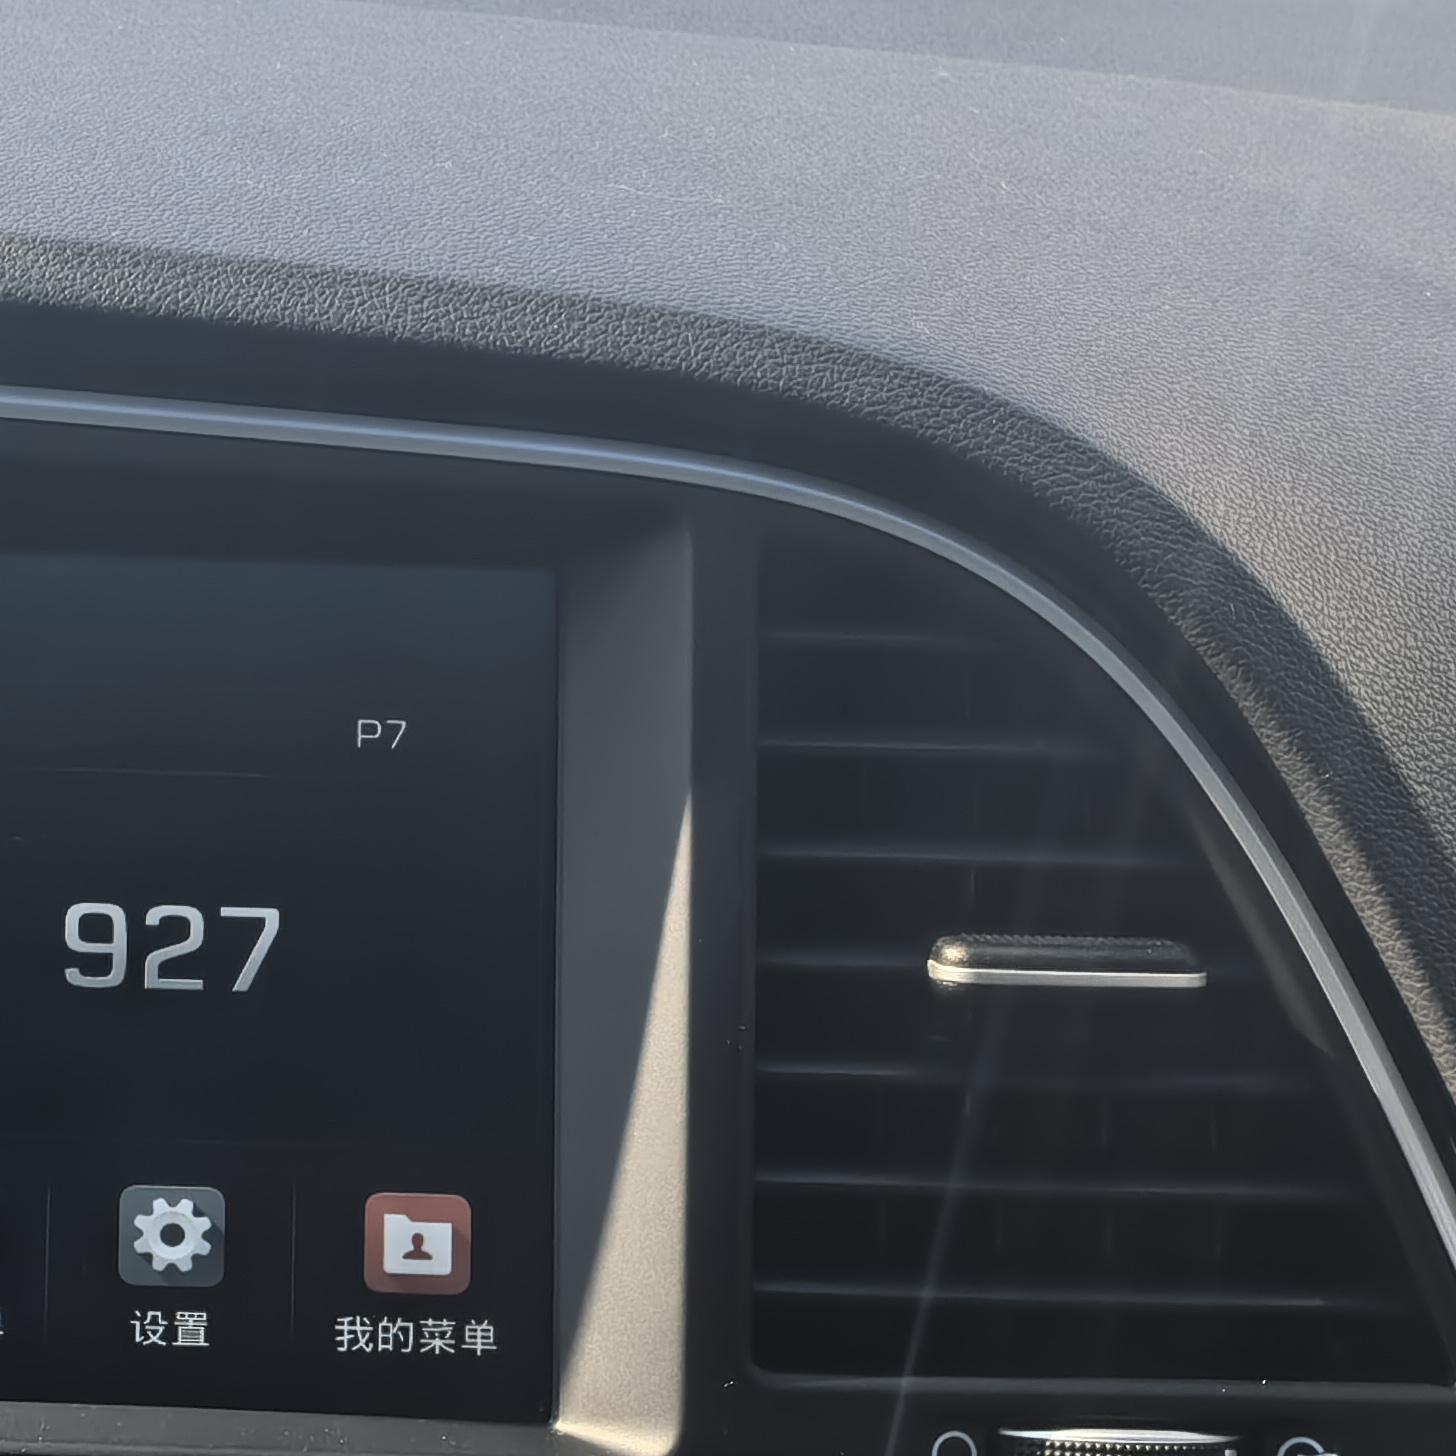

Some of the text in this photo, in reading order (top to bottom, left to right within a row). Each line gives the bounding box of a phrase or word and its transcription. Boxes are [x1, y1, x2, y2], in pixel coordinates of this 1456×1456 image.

[355, 717, 408, 750] P7
[63, 901, 281, 993] 927
[129, 1309, 211, 1348] 设置
[333, 1314, 498, 1357] 我的菜单
